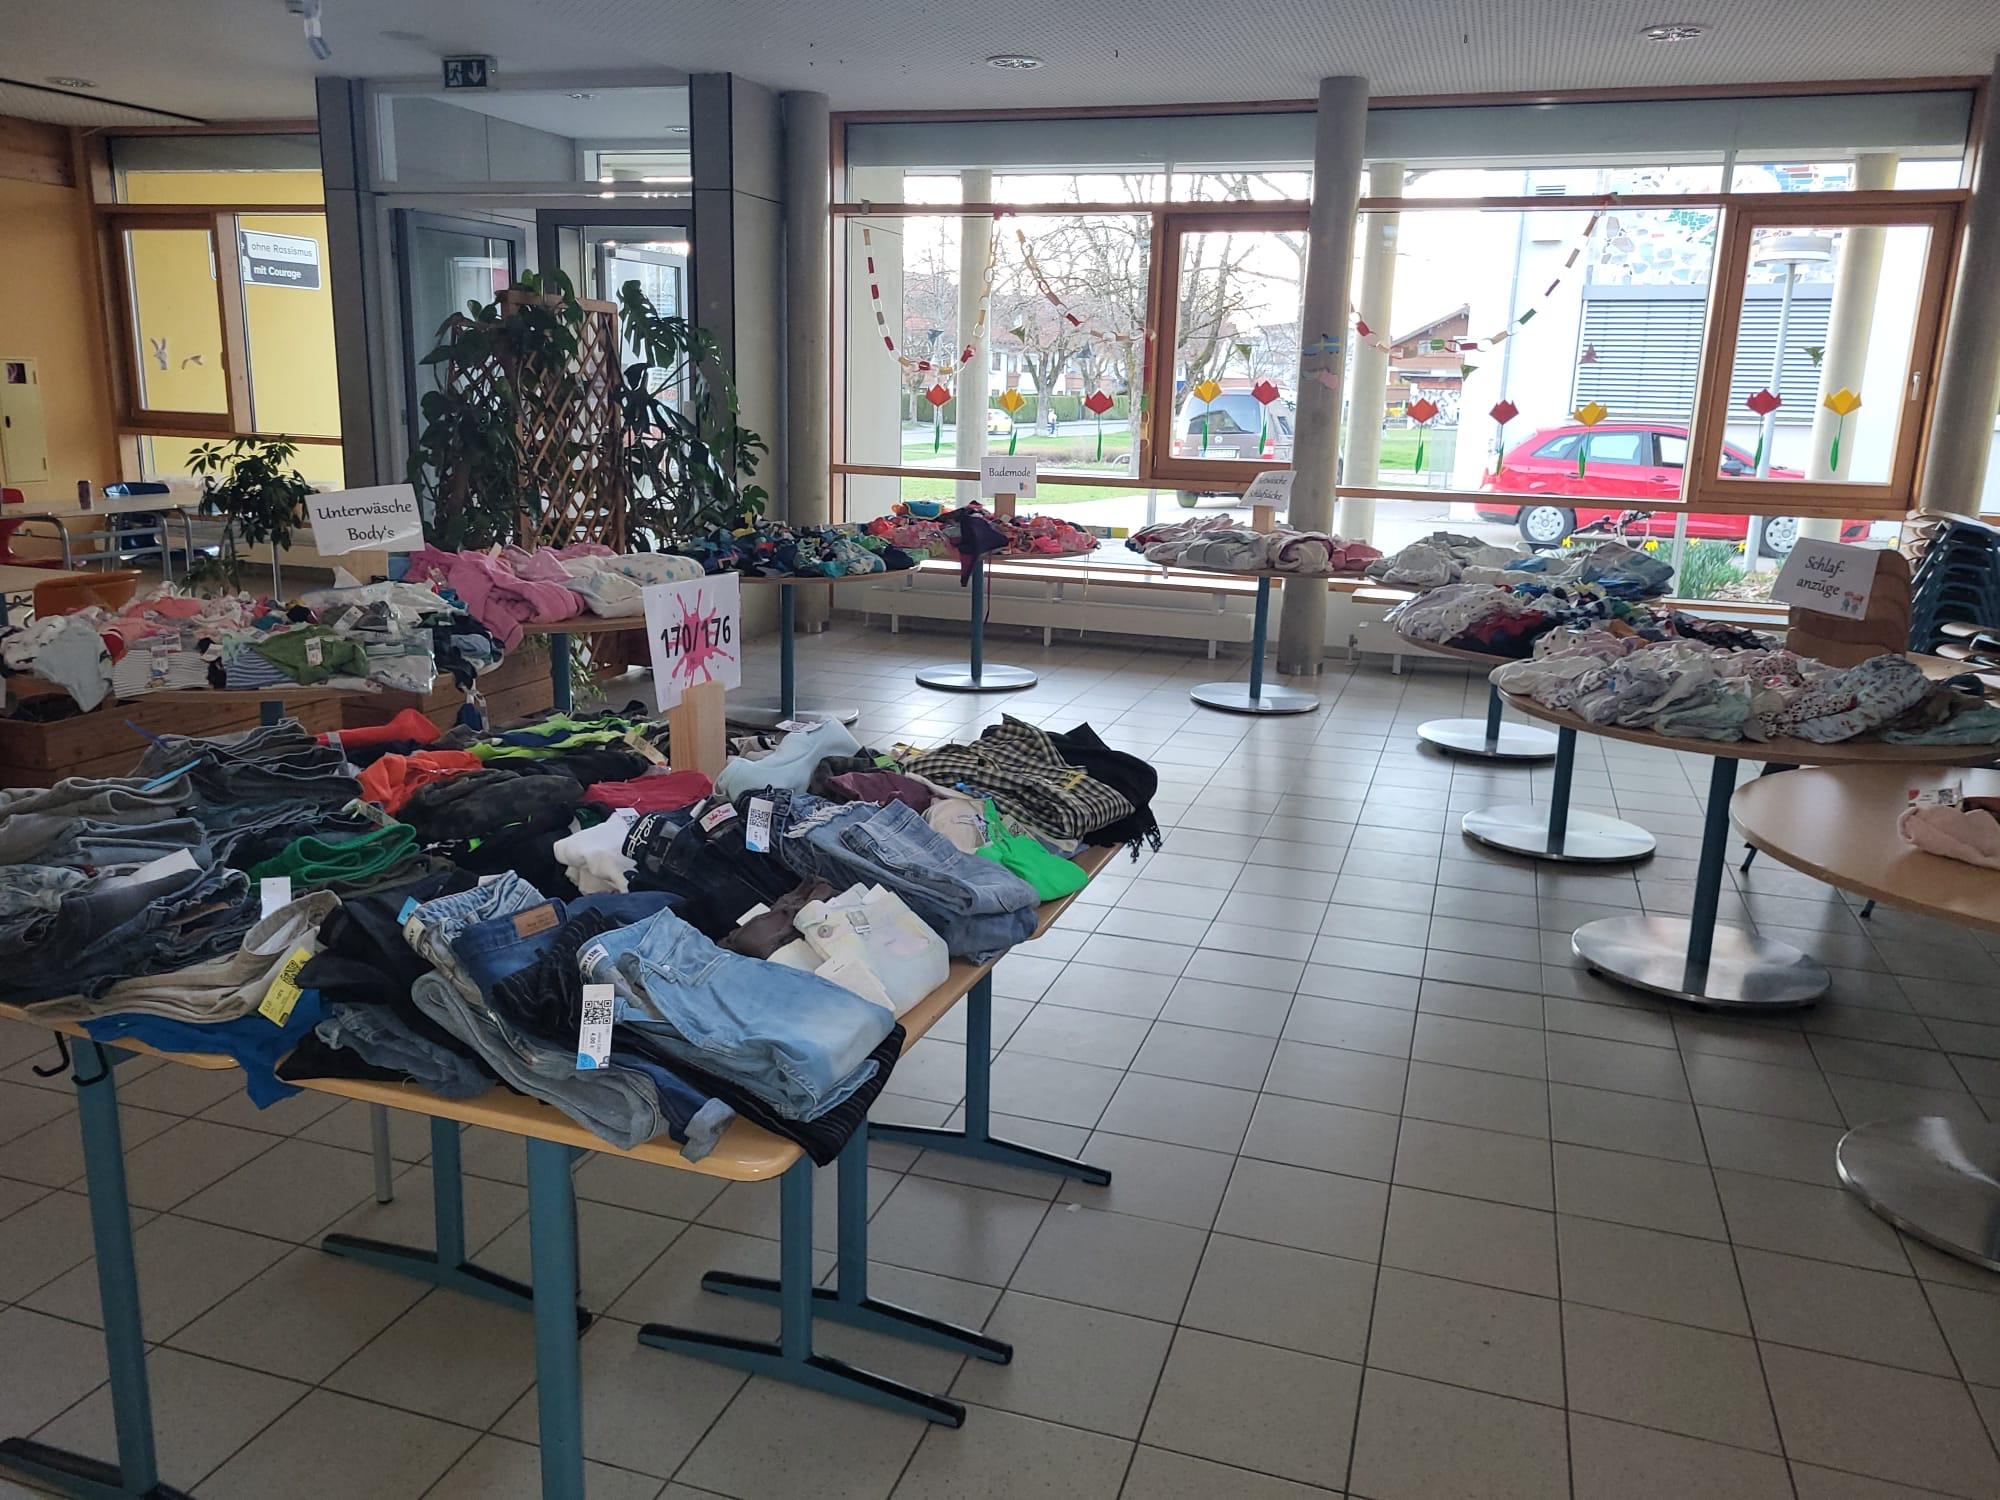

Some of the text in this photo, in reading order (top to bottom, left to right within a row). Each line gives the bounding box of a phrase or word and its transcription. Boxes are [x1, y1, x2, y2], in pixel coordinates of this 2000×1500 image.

[251, 243, 271, 252] ohne
[273, 244, 313, 257] Rassismus
[253, 265, 267, 275] mit
[268, 266, 302, 280] Courage
[988, 466, 1031, 477] Bademode
[316, 498, 413, 519] Unterwäsche
[1804, 556, 1846, 578] Schlaf-
[1795, 577, 1841, 598] anzüge
[660, 615, 731, 658] 170/176
